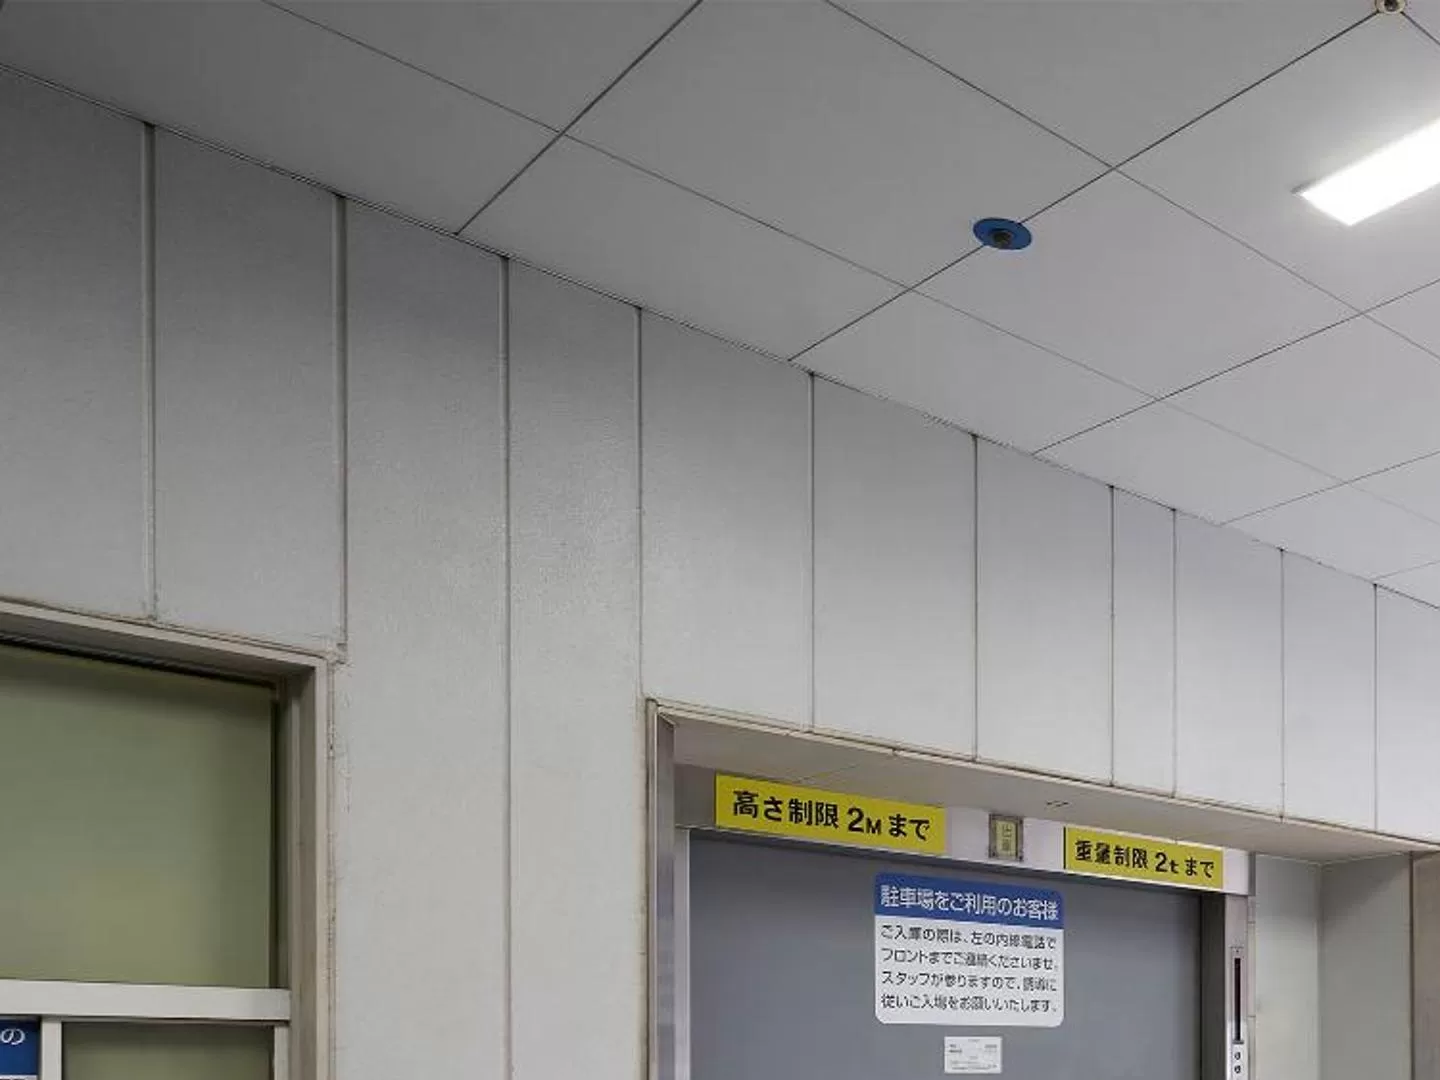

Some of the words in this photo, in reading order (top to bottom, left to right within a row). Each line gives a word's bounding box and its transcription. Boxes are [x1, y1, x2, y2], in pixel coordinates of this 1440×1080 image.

[880, 884, 1059, 921] 駐車場をご利用のお客様
[0, 1029, 25, 1045] の
